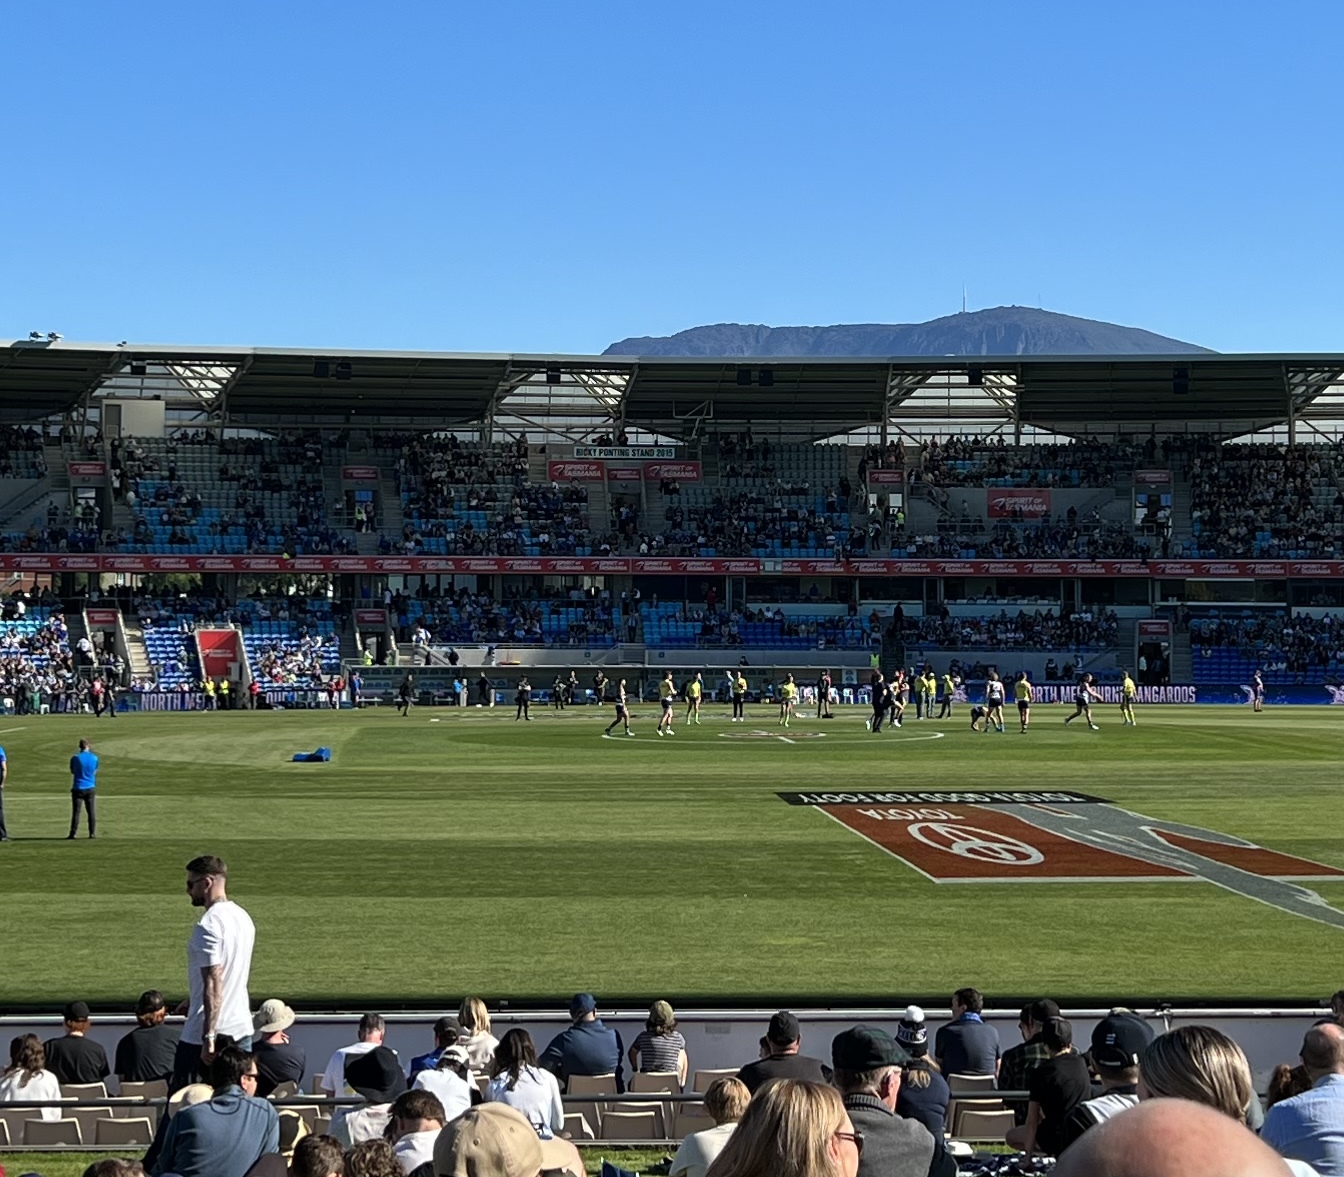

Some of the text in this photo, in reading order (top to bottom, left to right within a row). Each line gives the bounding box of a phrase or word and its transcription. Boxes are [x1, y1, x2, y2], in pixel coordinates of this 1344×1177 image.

[598, 448, 630, 457] PONTING
[631, 448, 655, 457] STAND
[656, 448, 673, 457] 2015
[1030, 686, 1057, 702] ORTH
[141, 692, 181, 710] NORTH
[798, 793, 874, 803] FOOTY
[868, 793, 923, 803] FOR
[918, 792, 990, 803] GOOD
[855, 808, 966, 821] TOYOTA
